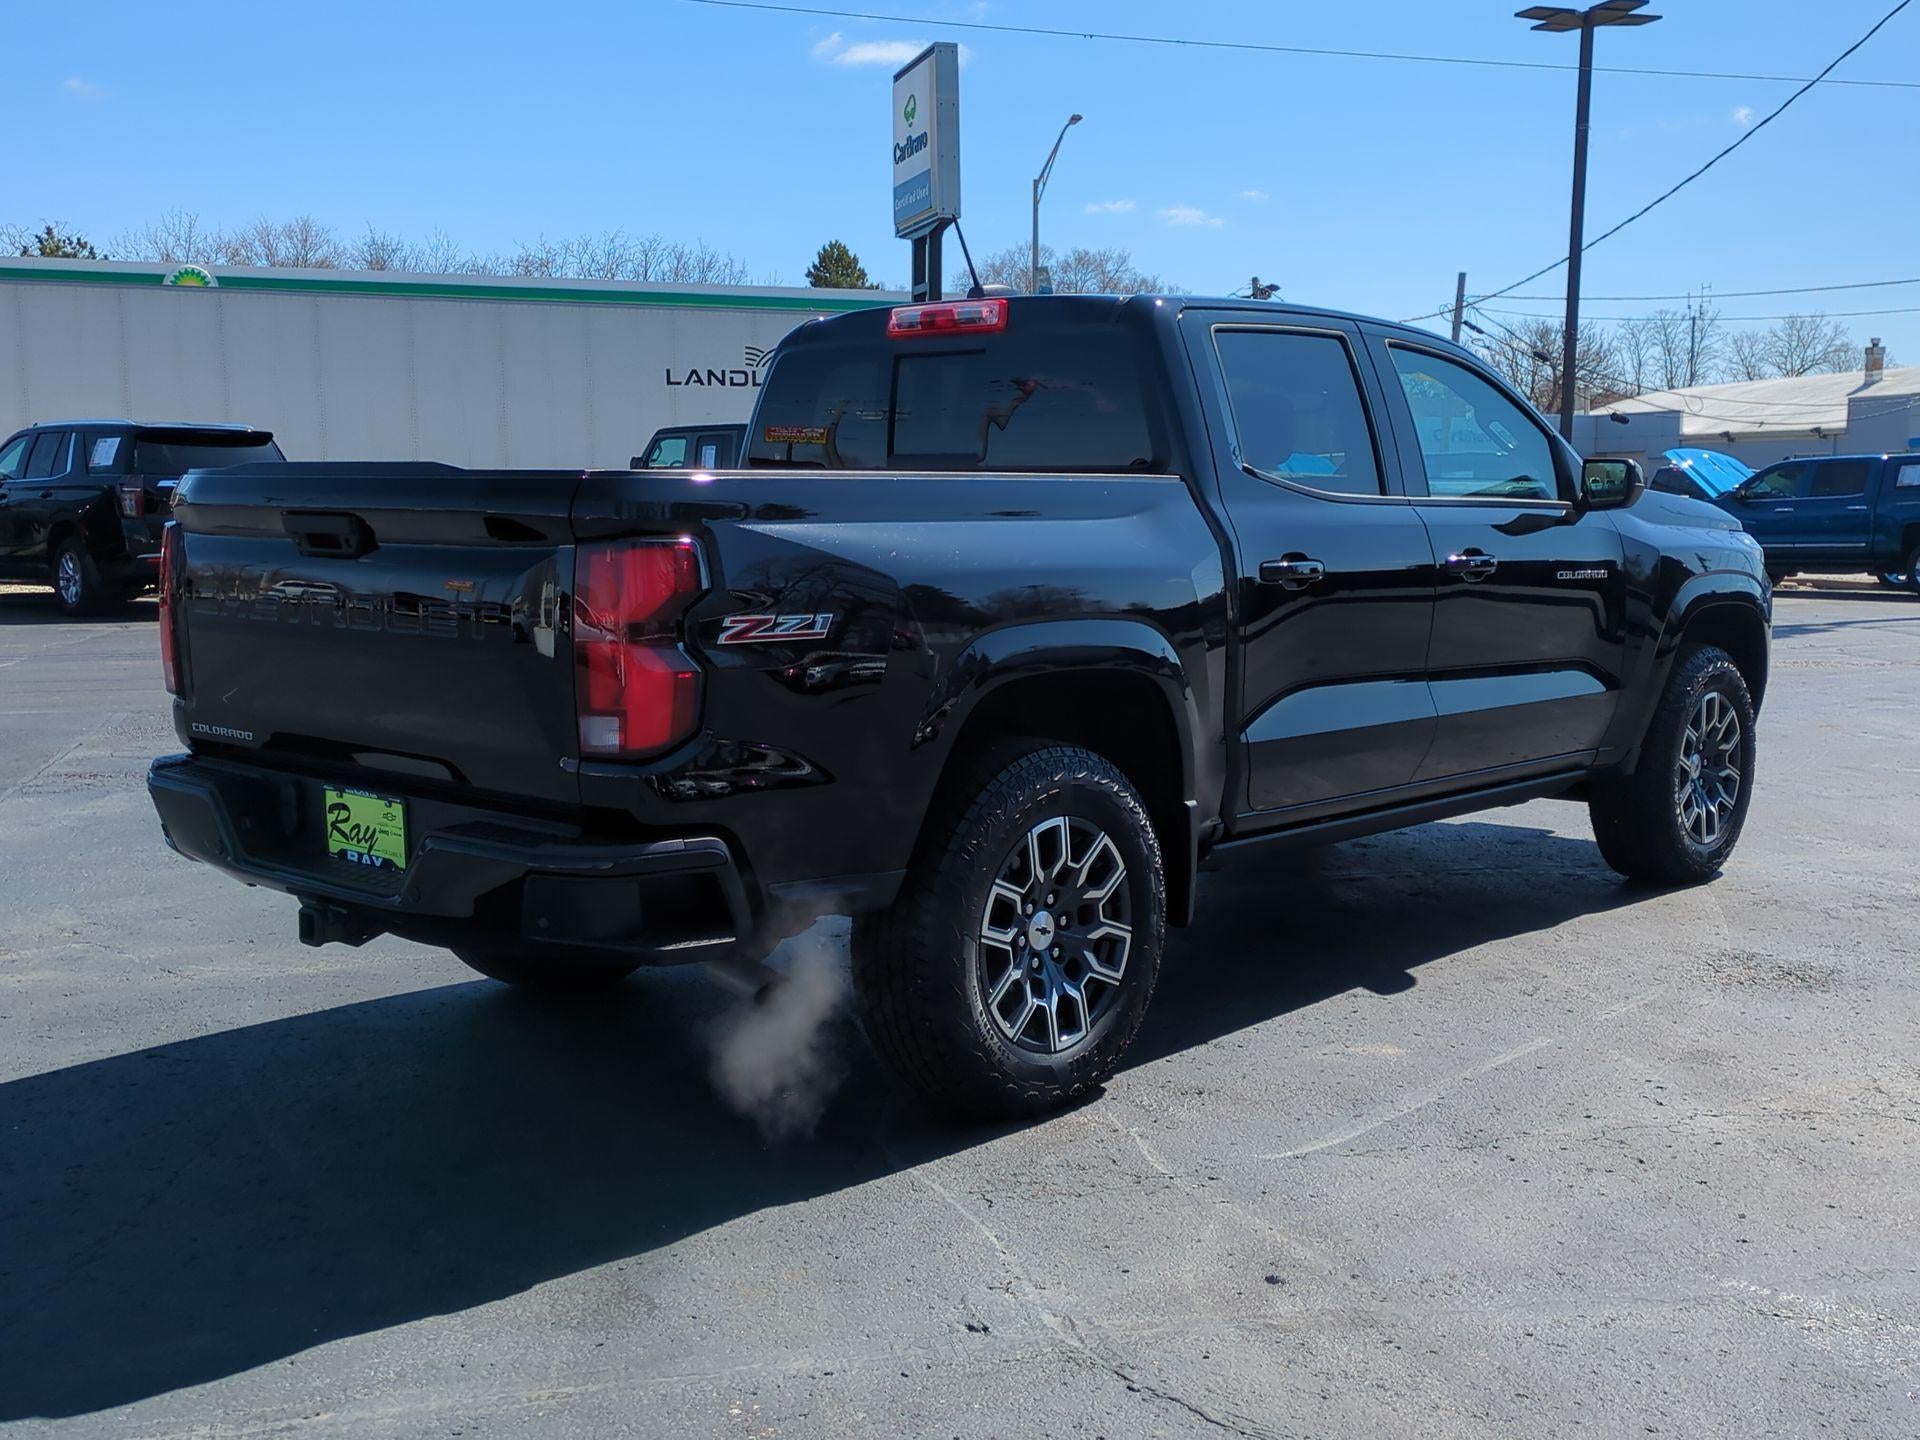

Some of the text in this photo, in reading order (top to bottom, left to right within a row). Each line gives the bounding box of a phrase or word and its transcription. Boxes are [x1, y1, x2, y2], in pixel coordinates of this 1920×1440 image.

[894, 131, 928, 165] CarBravo
[916, 183, 929, 200] Used
[1557, 569, 1608, 579] COLORADO
[716, 613, 833, 645] Z71
[191, 722, 253, 741] COLORADO
[327, 802, 379, 855] Ray
